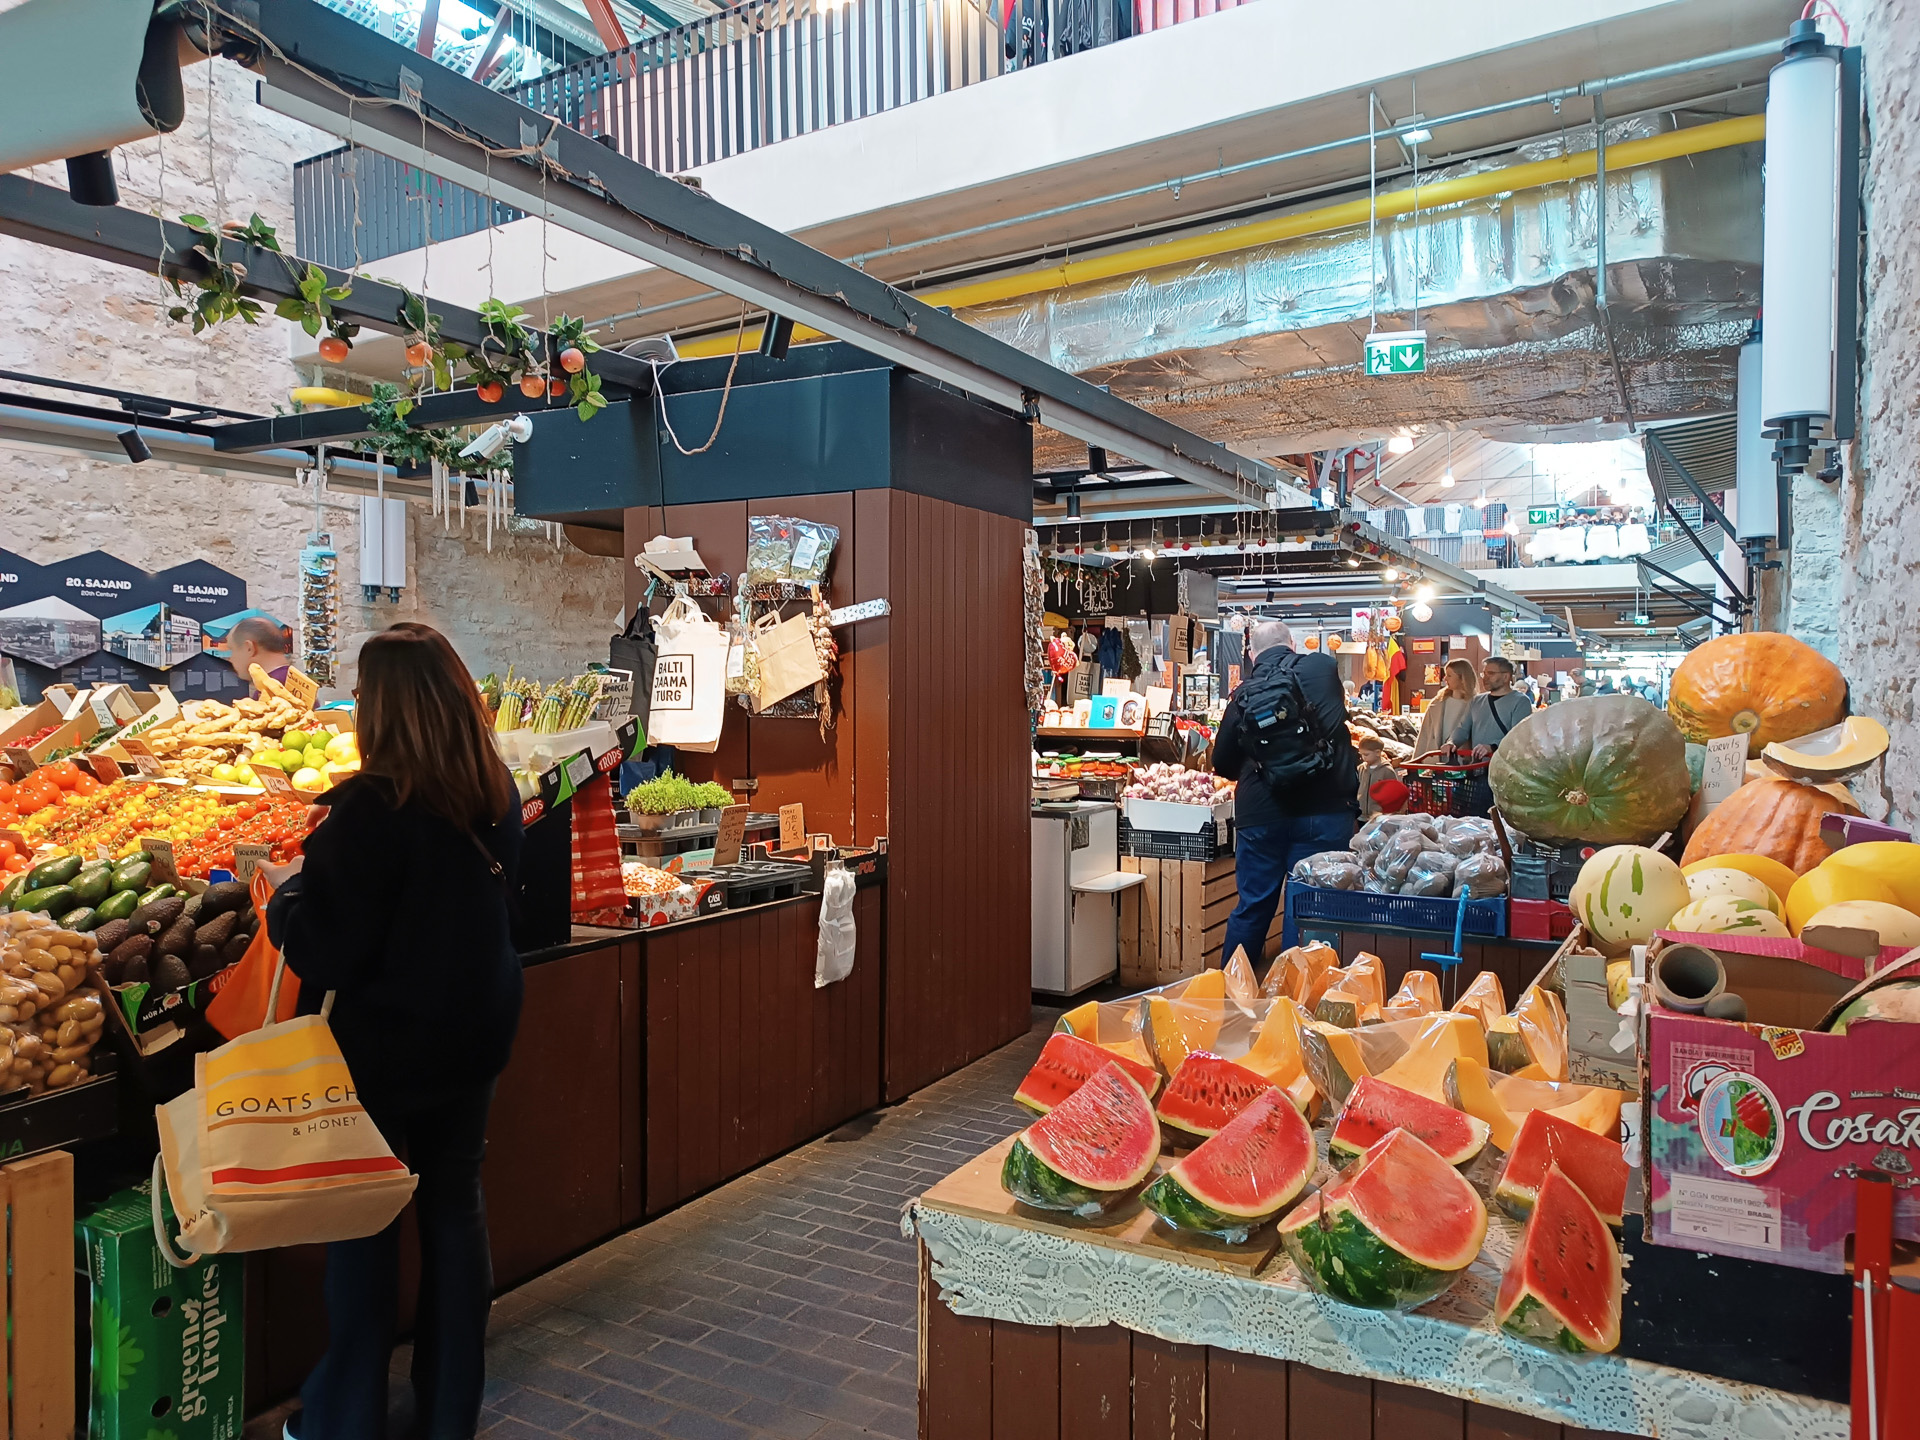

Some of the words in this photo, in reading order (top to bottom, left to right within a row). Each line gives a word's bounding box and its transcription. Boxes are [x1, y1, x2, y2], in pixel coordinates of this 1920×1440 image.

[66, 577, 84, 587] 20.
[85, 579, 132, 590] SAJAND
[172, 584, 187, 594] 21.
[188, 585, 229, 596] SAJAND
[96, 590, 118, 599] Century
[196, 596, 217, 604] Century
[658, 661, 683, 674] BALTI
[655, 676, 688, 688] JAAMA
[656, 690, 682, 701] TURG
[598, 749, 622, 771] TROPS
[521, 799, 544, 821] ROPS
[1775, 1040, 1803, 1058] 2025
[1704, 1051, 1751, 1063] WATERMELON
[216, 1093, 312, 1117] GOATS
[292, 1127, 301, 1136] &
[307, 1116, 358, 1133] HONEY
[1690, 1191, 1709, 1200] GGN
[1677, 1200, 1703, 1208] ORIGEN
[1747, 1210, 1774, 1220] BRASIL
[196, 1264, 228, 1384] tropics
[177, 1322, 208, 1423] green
